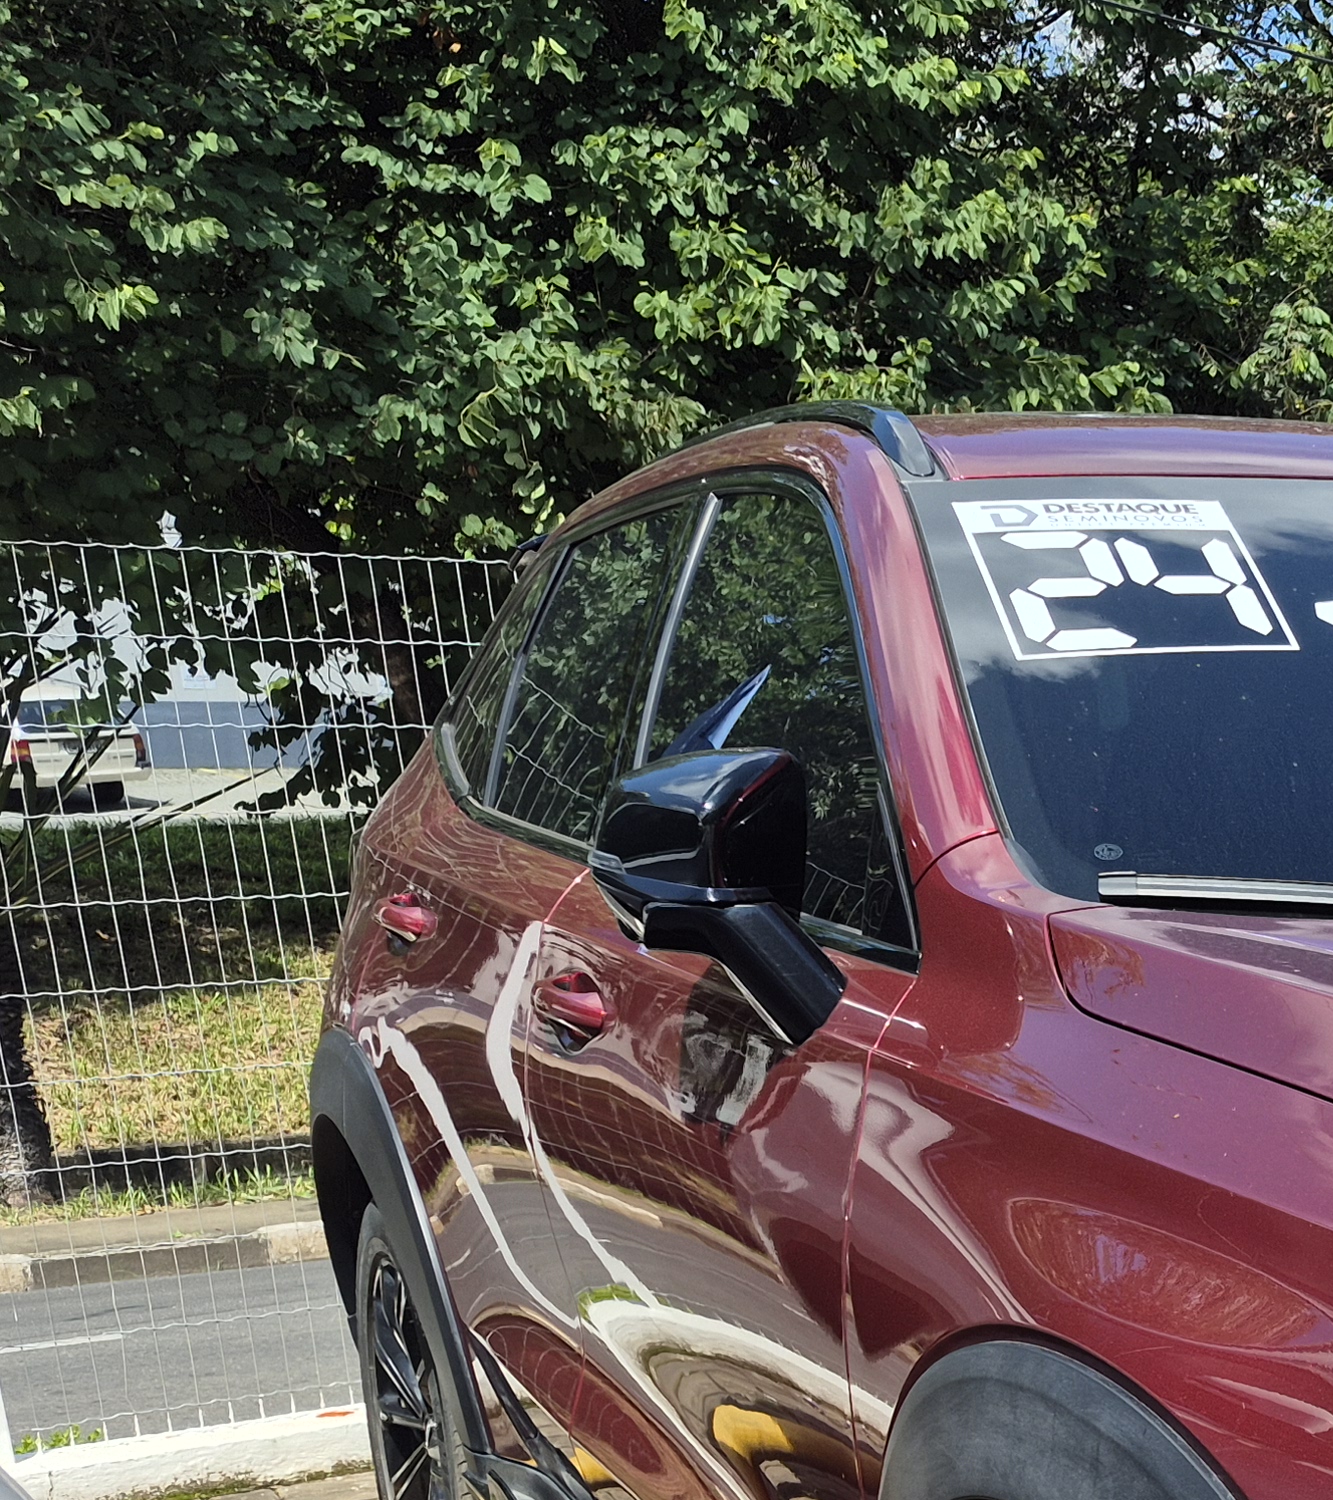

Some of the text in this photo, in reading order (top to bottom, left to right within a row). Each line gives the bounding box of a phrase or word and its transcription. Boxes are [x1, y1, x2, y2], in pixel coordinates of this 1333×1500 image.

[1042, 503, 1198, 514] DESTAQUE
[1049, 514, 1203, 523] SEMINOVOS
[1000, 531, 1272, 650] 24
